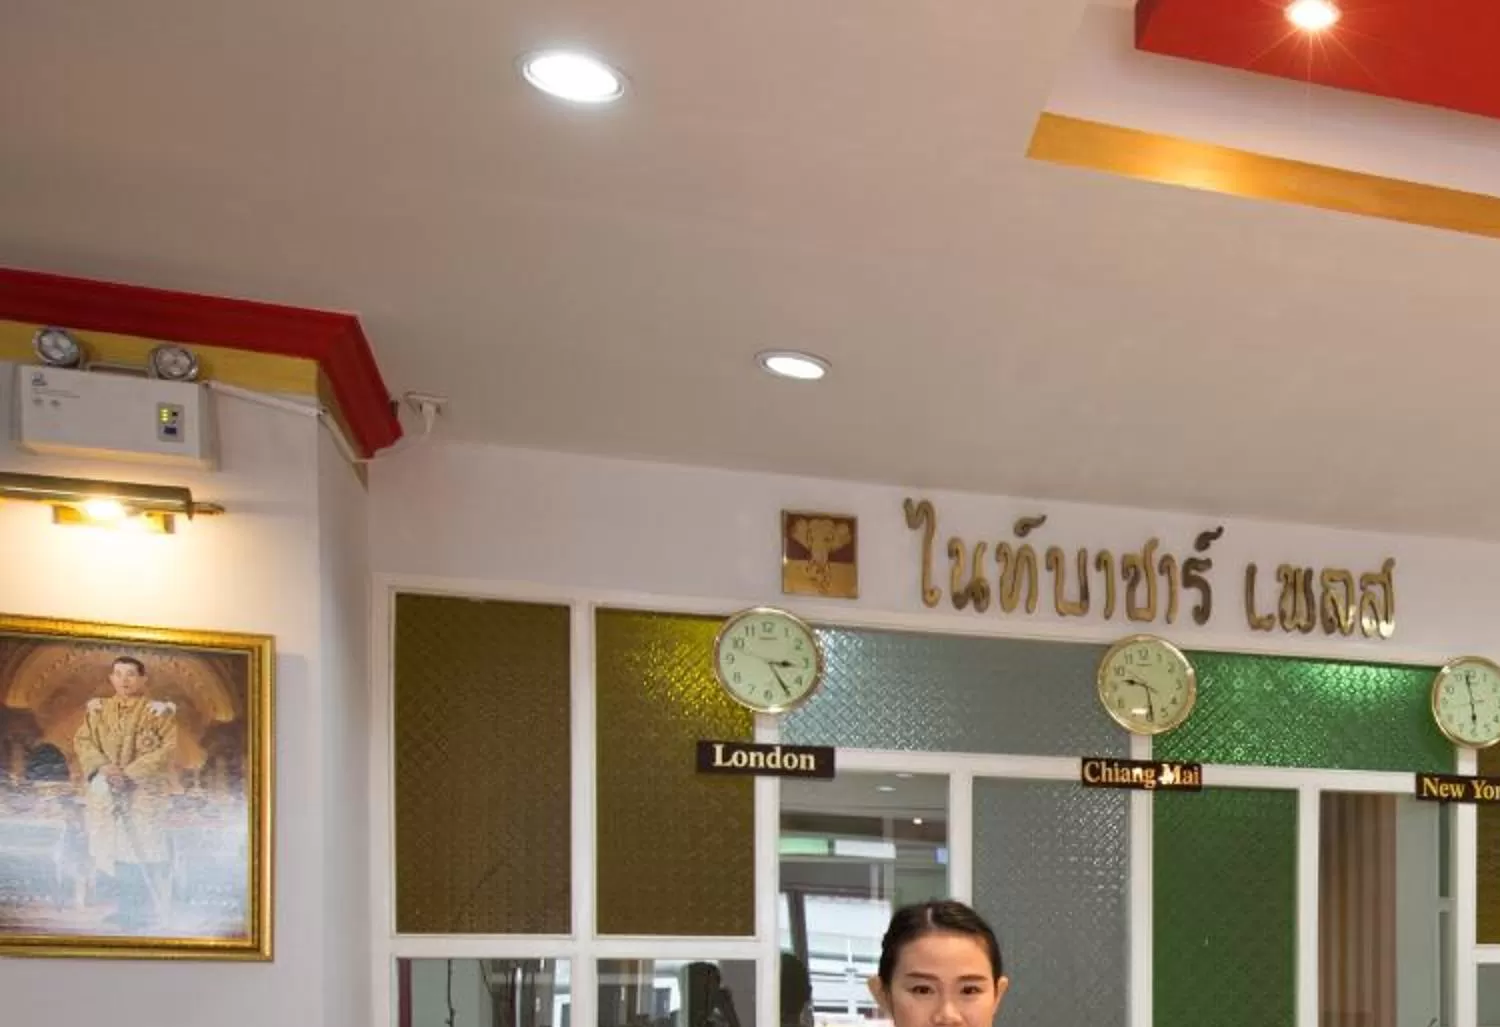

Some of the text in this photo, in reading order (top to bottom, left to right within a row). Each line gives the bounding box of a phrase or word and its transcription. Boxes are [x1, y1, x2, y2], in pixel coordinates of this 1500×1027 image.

[1244, 556, 1396, 639] เพลส
[713, 743, 816, 771] London
[1083, 761, 1200, 789] Chiang Mai
[1422, 777, 1466, 797] New
